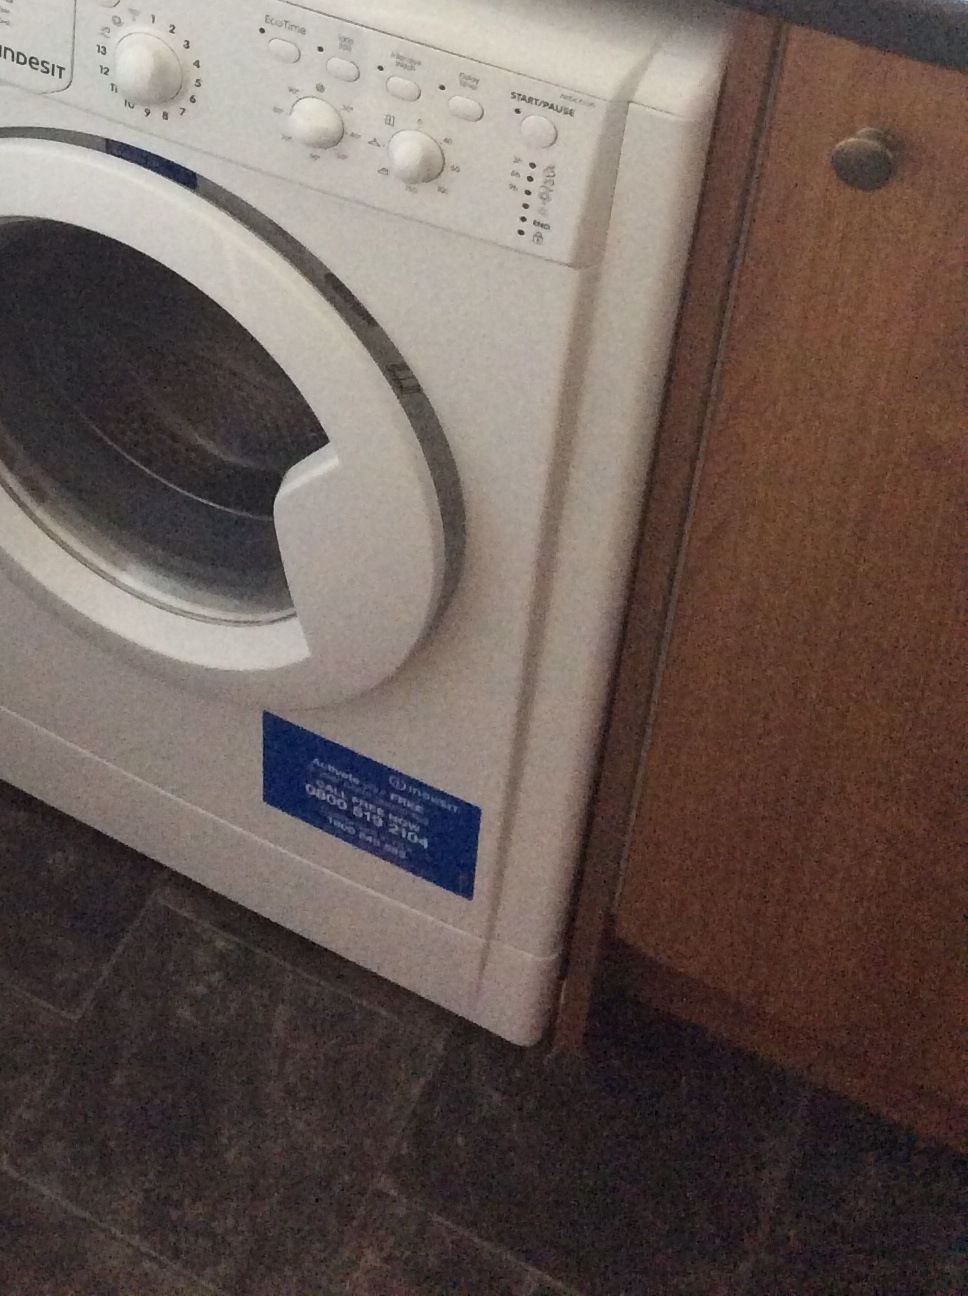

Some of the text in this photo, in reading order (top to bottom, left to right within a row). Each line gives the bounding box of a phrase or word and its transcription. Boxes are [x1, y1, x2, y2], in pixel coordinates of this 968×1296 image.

[151, 14, 156, 24] 1
[169, 24, 176, 34] 2
[265, 14, 306, 35] EcoTime
[183, 39, 190, 49] 3
[96, 44, 107, 55] 13
[193, 59, 201, 69] 4
[100, 65, 110, 76] 12
[194, 79, 202, 88] 5
[189, 95, 196, 104] 6
[510, 91, 575, 117] START/PAUSE
[144, 108, 151, 117] 9
[162, 111, 169, 121] 8
[179, 107, 186, 116] 7
[533, 219, 551, 230] END
[306, 784, 347, 810] 0800
[389, 823, 428, 849] 2104
[389, 813, 420, 833] NOW
